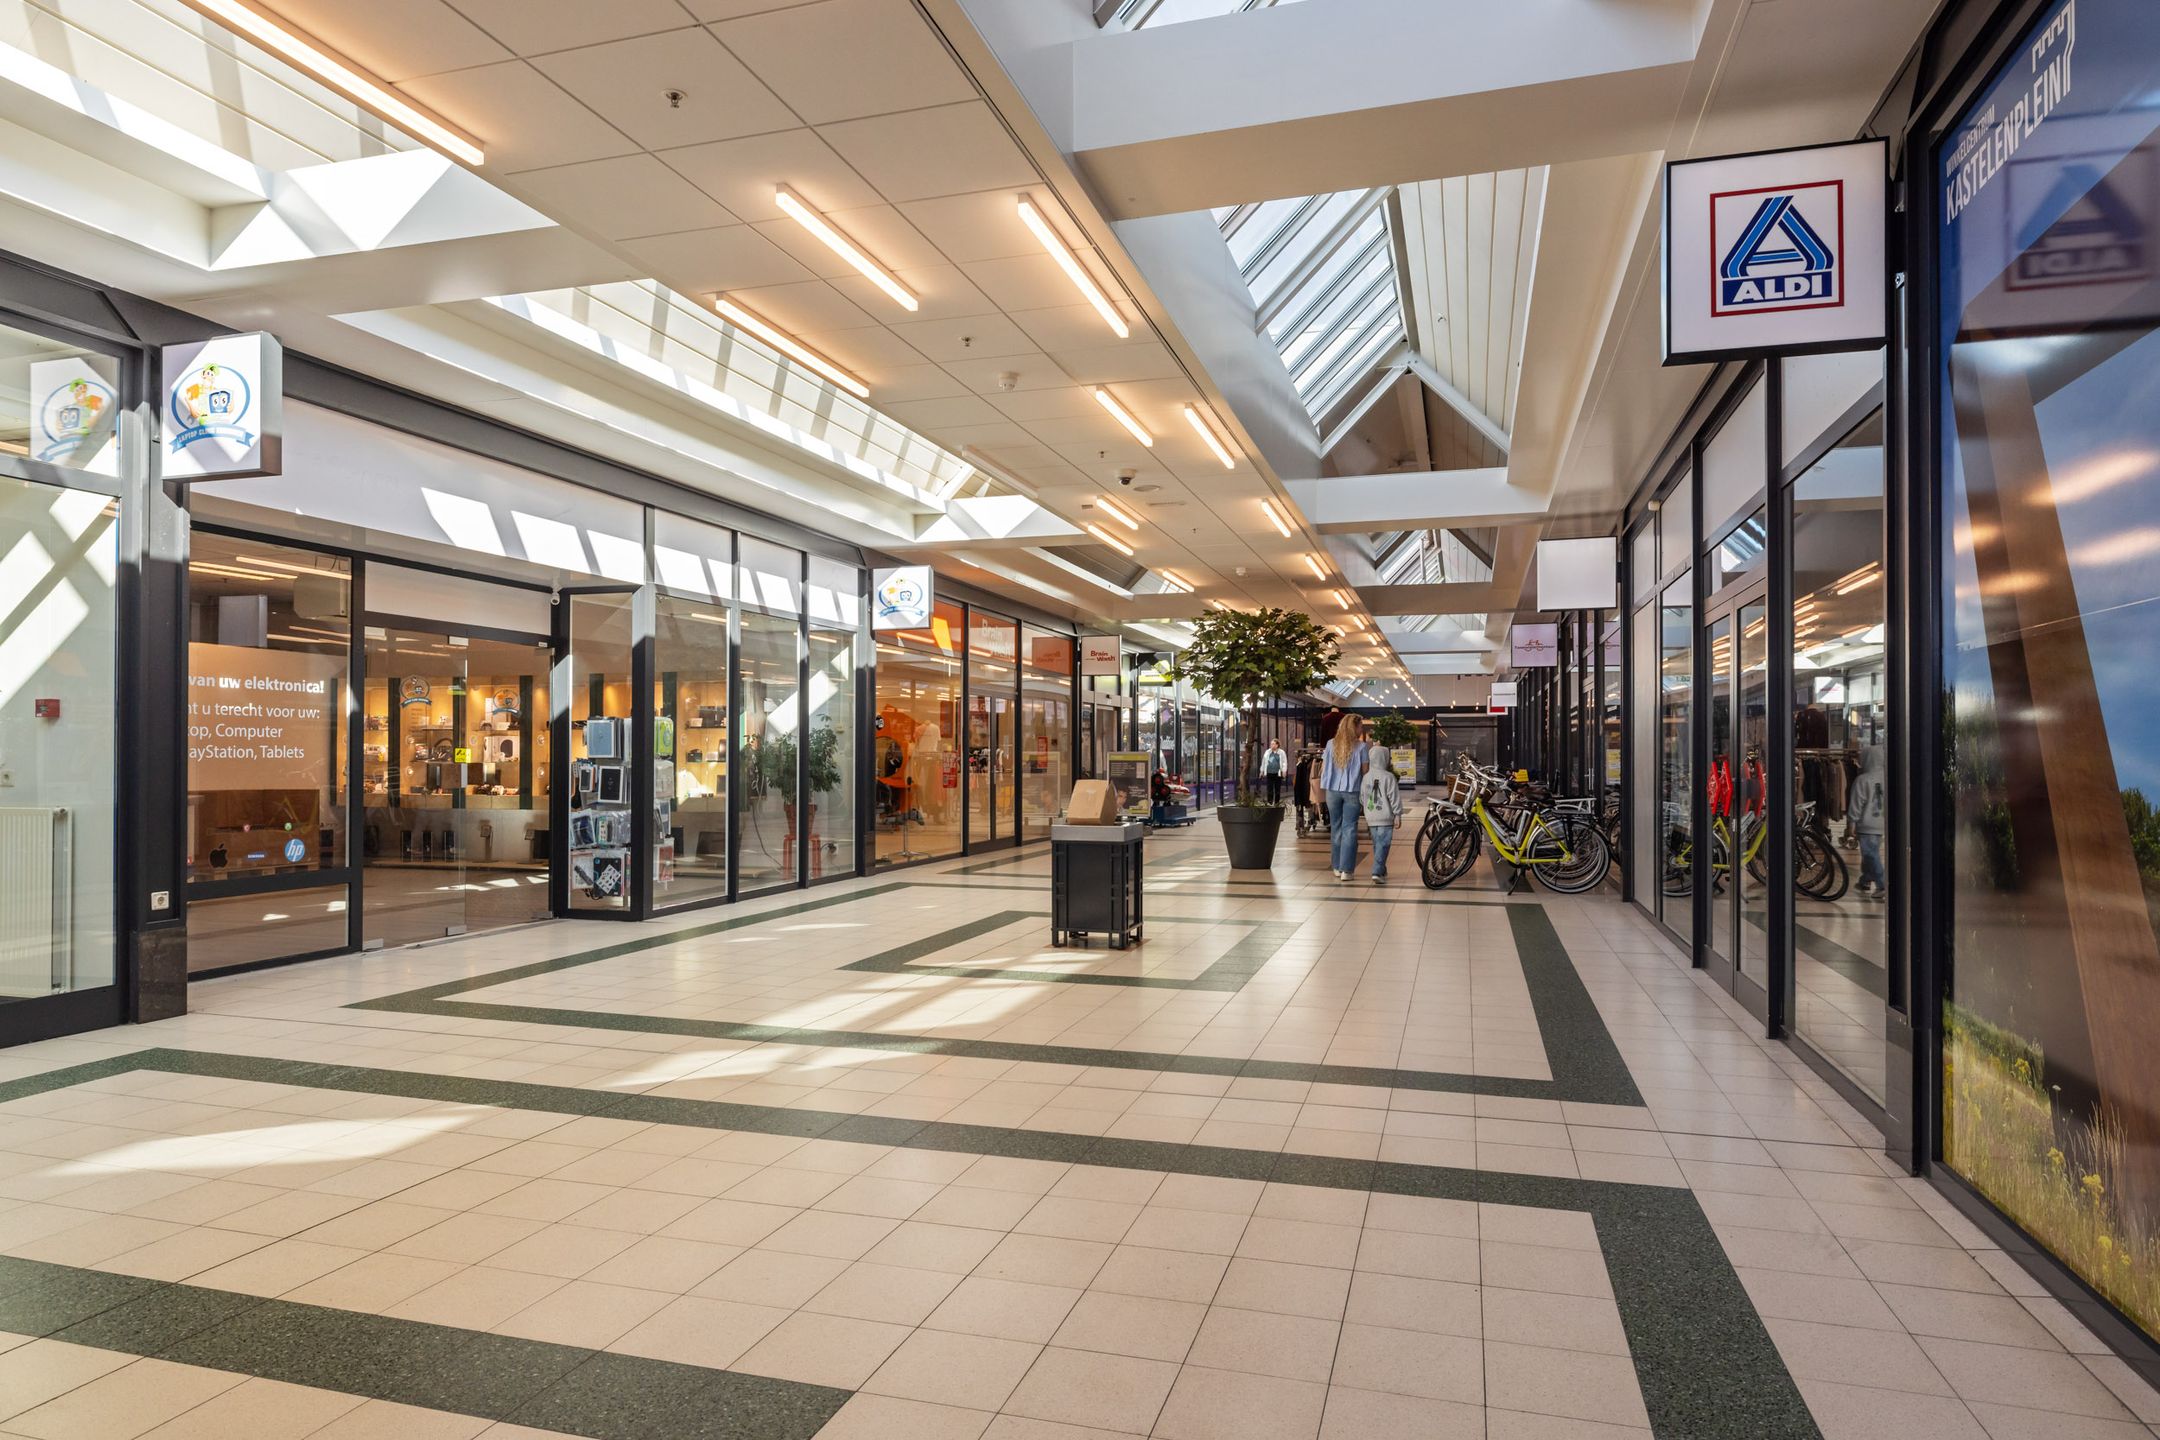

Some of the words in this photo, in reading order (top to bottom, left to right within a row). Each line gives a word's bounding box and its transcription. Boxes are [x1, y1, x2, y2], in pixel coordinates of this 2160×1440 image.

[1946, 54, 2060, 226] KASTELENPLEIN
[1946, 104, 1995, 177] WINKELCENTRUM
[1732, 274, 1823, 303] ALDI
[188, 675, 216, 687] van
[219, 677, 241, 689] uw
[244, 676, 325, 694] elektronica!
[202, 704, 211, 716] u
[215, 703, 263, 717] terecht
[266, 707, 296, 719] voor
[298, 708, 320, 719] uw:
[215, 723, 283, 740] Computer
[260, 745, 305, 759] Tablets
[287, 839, 304, 862] hp
